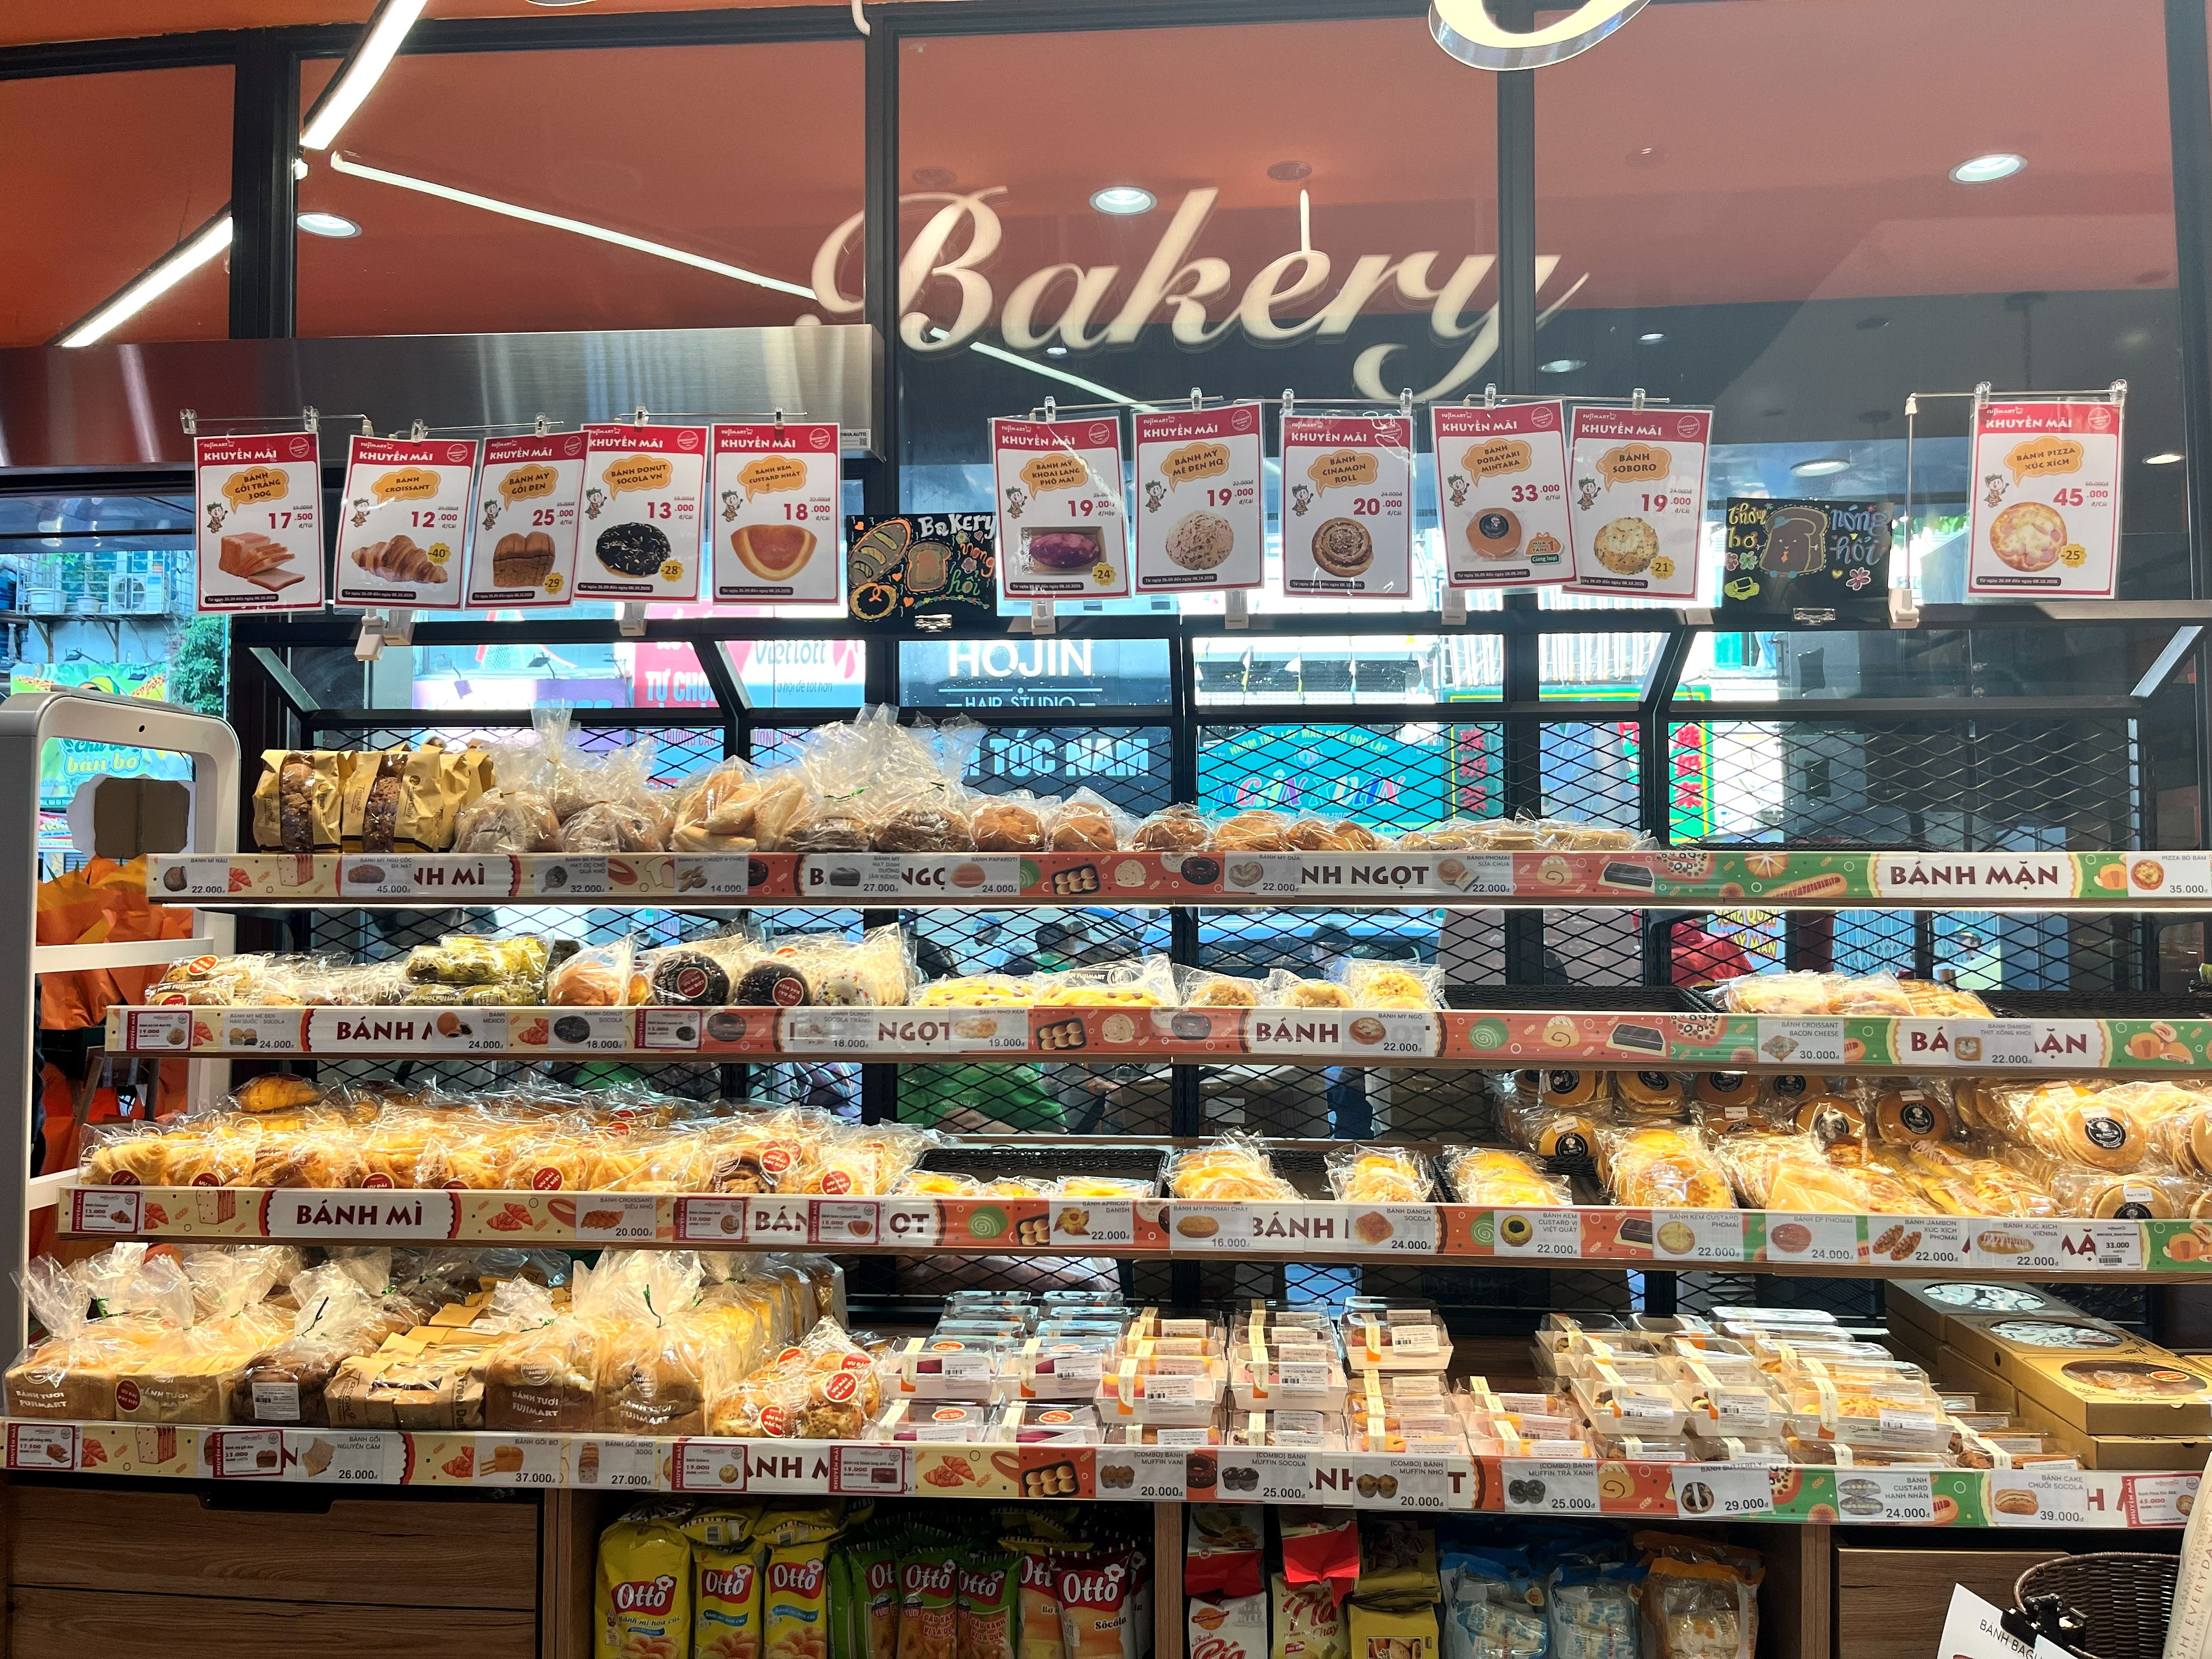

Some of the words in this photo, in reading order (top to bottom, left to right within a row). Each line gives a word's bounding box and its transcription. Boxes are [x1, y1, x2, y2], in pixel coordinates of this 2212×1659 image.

[809, 184, 1590, 400] Bakery
[2045, 417, 2072, 428] MÃI
[1194, 425, 1218, 435] MÃI
[1637, 425, 1661, 436] MÃI
[772, 439, 795, 448] MÃI
[1484, 444, 1508, 455] BÁNH
[2016, 452, 2044, 462] BÁNH
[2047, 447, 2075, 456] PIZZA
[410, 452, 433, 461] MÃI
[1175, 454, 1201, 466] BÁNH
[1330, 455, 1355, 465] BÁNH
[1477, 451, 1520, 465] DORAYAKI
[1619, 452, 1650, 462] BÁNH
[1036, 462, 1057, 470] BÁNH
[1188, 462, 1206, 472] ĐEN
[1209, 459, 1223, 467] HQ
[1481, 460, 1520, 473] MINTAKA
[1612, 462, 1656, 472] SOBORO
[2024, 461, 2044, 471] XÚC
[2046, 456, 2069, 467] XÍCH
[611, 469, 635, 477] BÁNH
[637, 465, 667, 473] DONUT
[755, 466, 775, 475] BÁNH
[1032, 471, 1058, 479] KHOAI
[1059, 468, 1080, 477] LANG
[1322, 464, 1366, 476] CINAMON
[244, 472, 268, 482] BÁNH
[509, 476, 533, 485] BÁNH
[617, 475, 648, 484] SOCOLA
[749, 475, 779, 484] CUSTARD
[1335, 474, 1357, 483] ROLL
[385, 483, 430, 493] CROISSANT
[528, 482, 546, 492] ĐEN
[249, 490, 270, 500] 300G
[950, 639, 1092, 678] HOJIN
[454, 863, 484, 885] MÌ
[1352, 866, 1429, 890] NGỌT
[1891, 861, 1976, 884] BÁNH
[1985, 861, 2057, 890] MẶN
[337, 1018, 413, 1040] BÁNH
[1256, 1017, 1338, 1042] BÁNH
[296, 1200, 377, 1224] BÁNH
[386, 1200, 421, 1225] MÌ
[1722, 1462, 1762, 1471] BUTTERFLY
[774, 1564, 817, 1593] Otto
[1063, 1573, 1118, 1604] Otto
[616, 1581, 667, 1609] Otto
